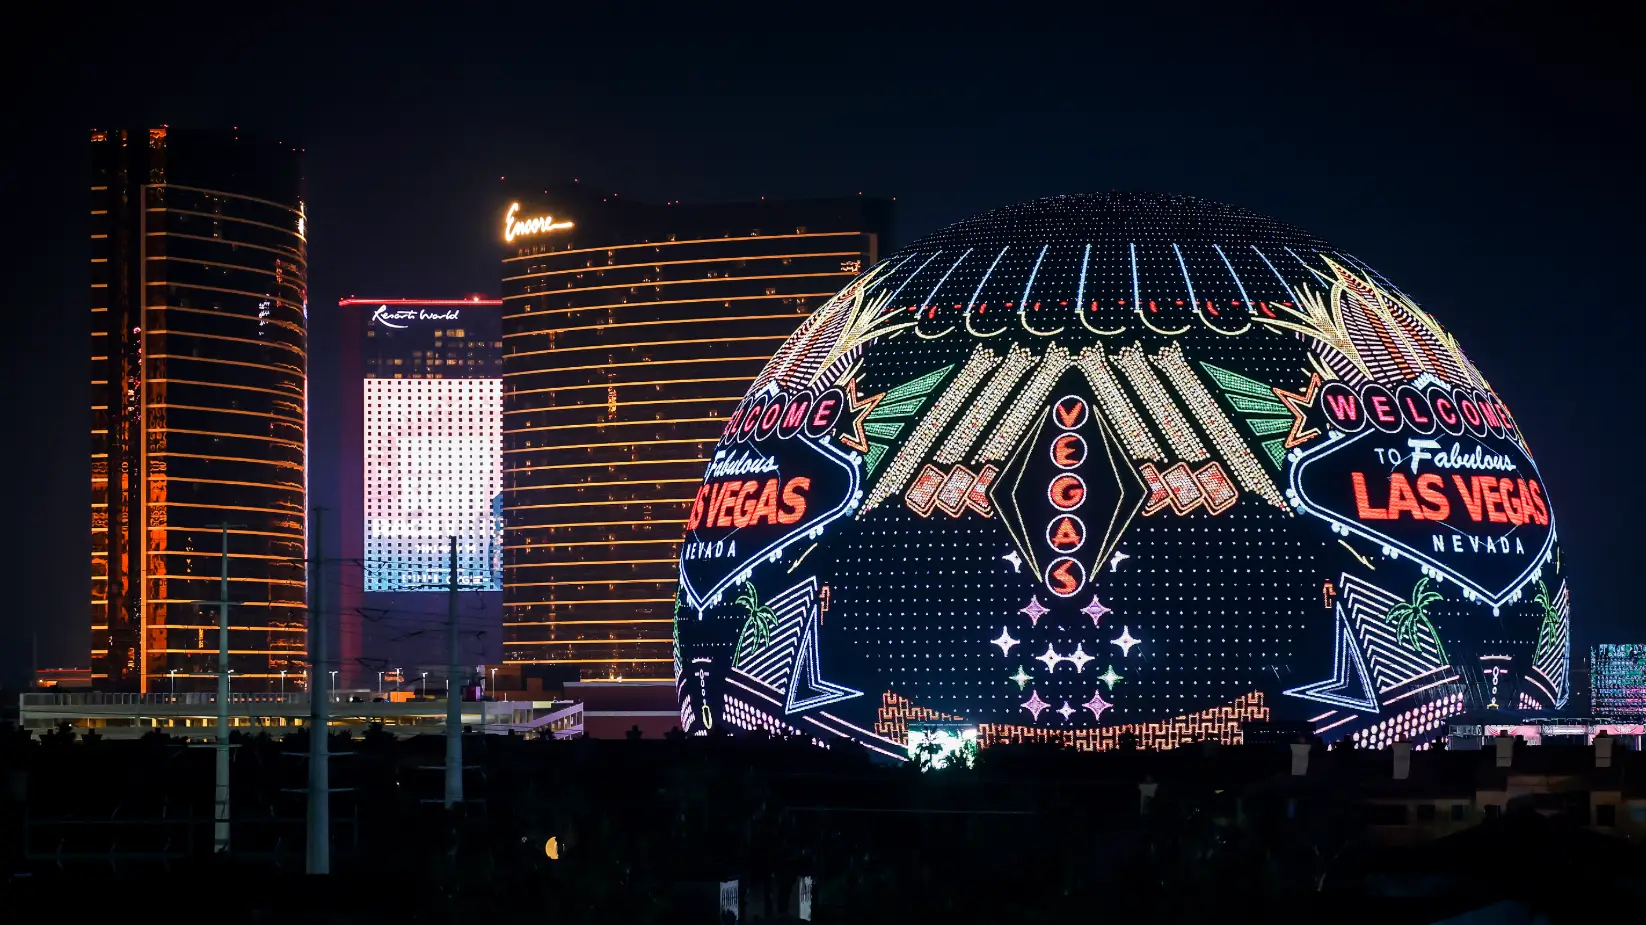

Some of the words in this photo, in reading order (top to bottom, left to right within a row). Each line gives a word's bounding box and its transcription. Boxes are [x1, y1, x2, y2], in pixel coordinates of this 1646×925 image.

[505, 203, 574, 242] Encore
[372, 305, 417, 328] Resorts
[420, 309, 459, 321] World
[1326, 395, 1513, 429] WELCOME
[1374, 448, 1400, 465] TO
[1407, 438, 1516, 474] Fabulous
[706, 477, 811, 528] VEGAS
[1050, 401, 1084, 594] VEGAS
[1351, 472, 1450, 520] LAS
[1452, 475, 1549, 525] VEGAS
[1432, 535, 1525, 555] NEVADA
